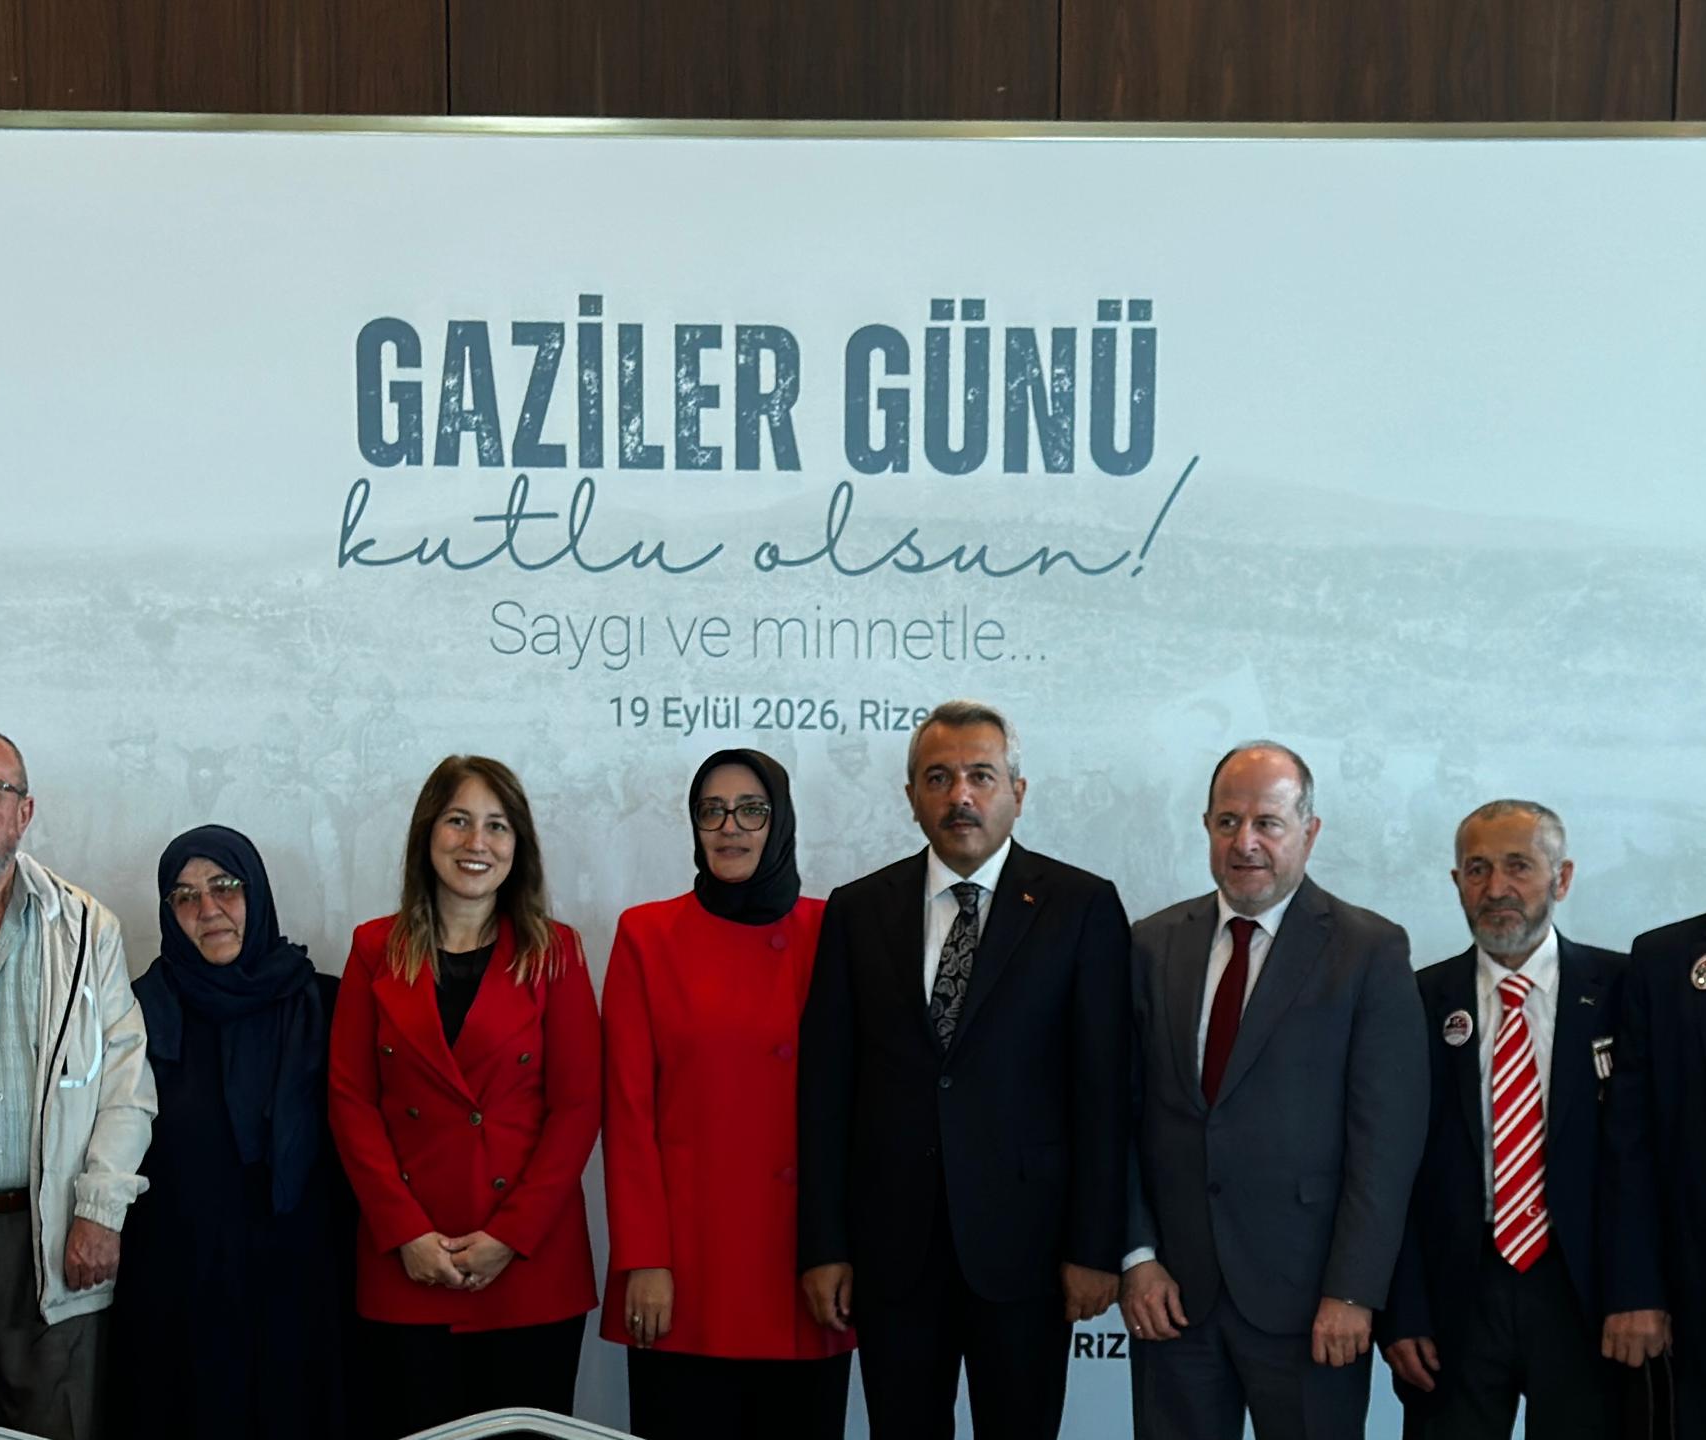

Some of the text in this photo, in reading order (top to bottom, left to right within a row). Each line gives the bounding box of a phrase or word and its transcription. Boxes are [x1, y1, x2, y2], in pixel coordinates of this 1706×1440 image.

[355, 293, 1158, 477] GAZİLER GÜNÜ
[338, 455, 1200, 578] kutlu olsun!
[489, 600, 1048, 670] Saygı ve minnetle...
[609, 697, 930, 736] 19 Eylül 2026, Rize
[1074, 1332, 1127, 1359] RİZ
